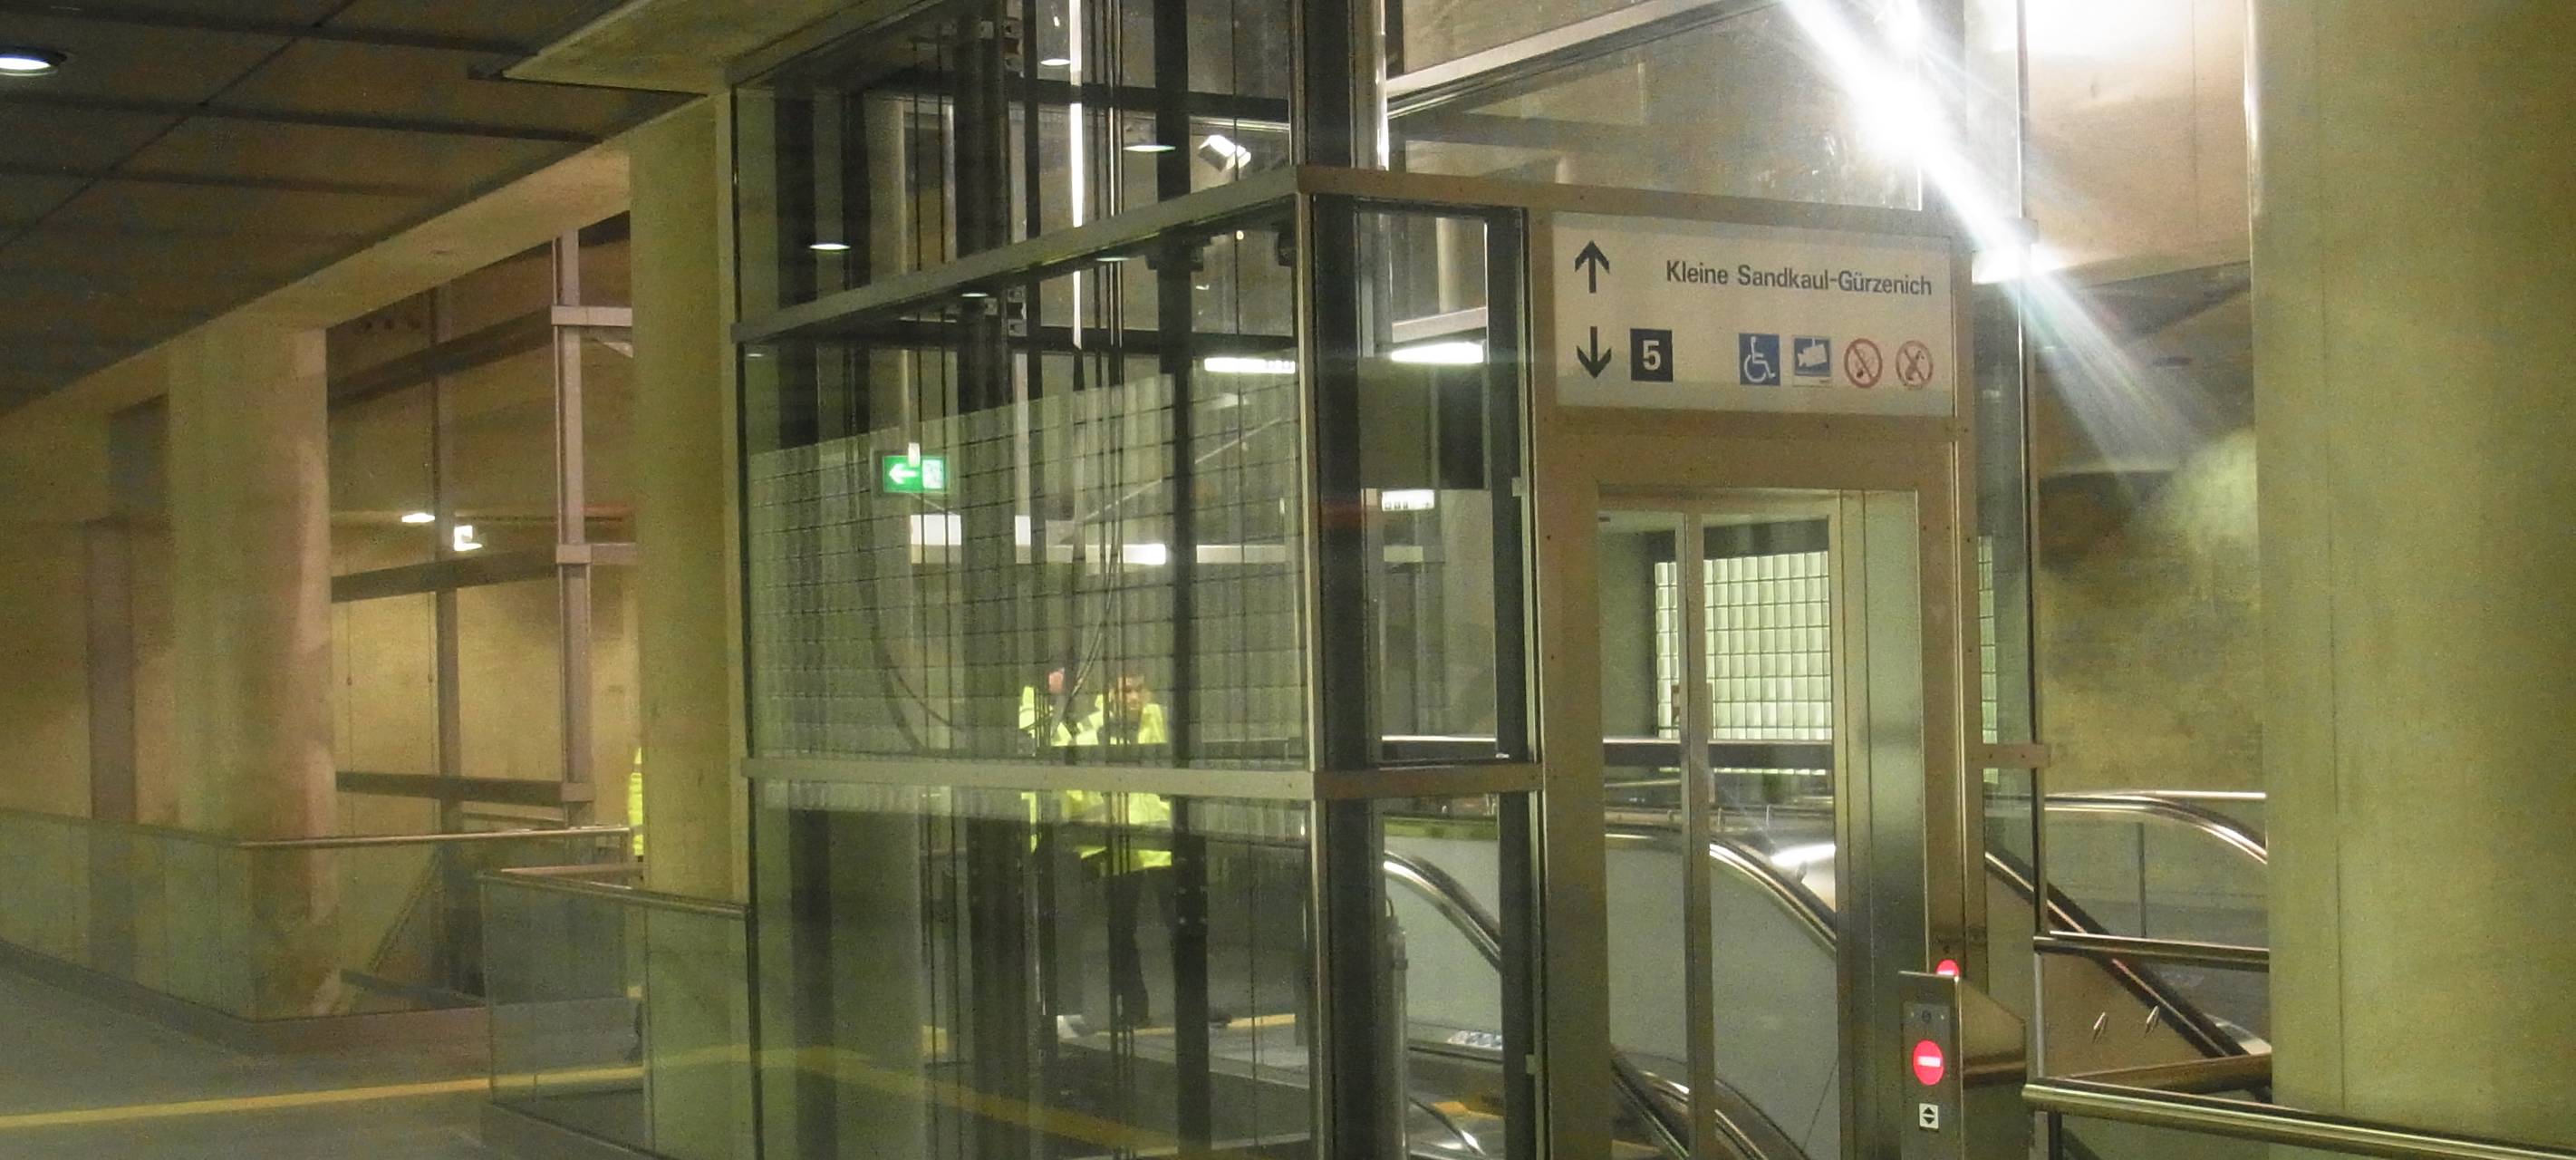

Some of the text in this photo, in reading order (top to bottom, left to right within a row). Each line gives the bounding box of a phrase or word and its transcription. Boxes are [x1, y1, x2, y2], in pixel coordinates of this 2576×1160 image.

[1665, 260, 1933, 295] Kleine Sandkaul-Gürzenich
[1642, 340, 1662, 371] 5
